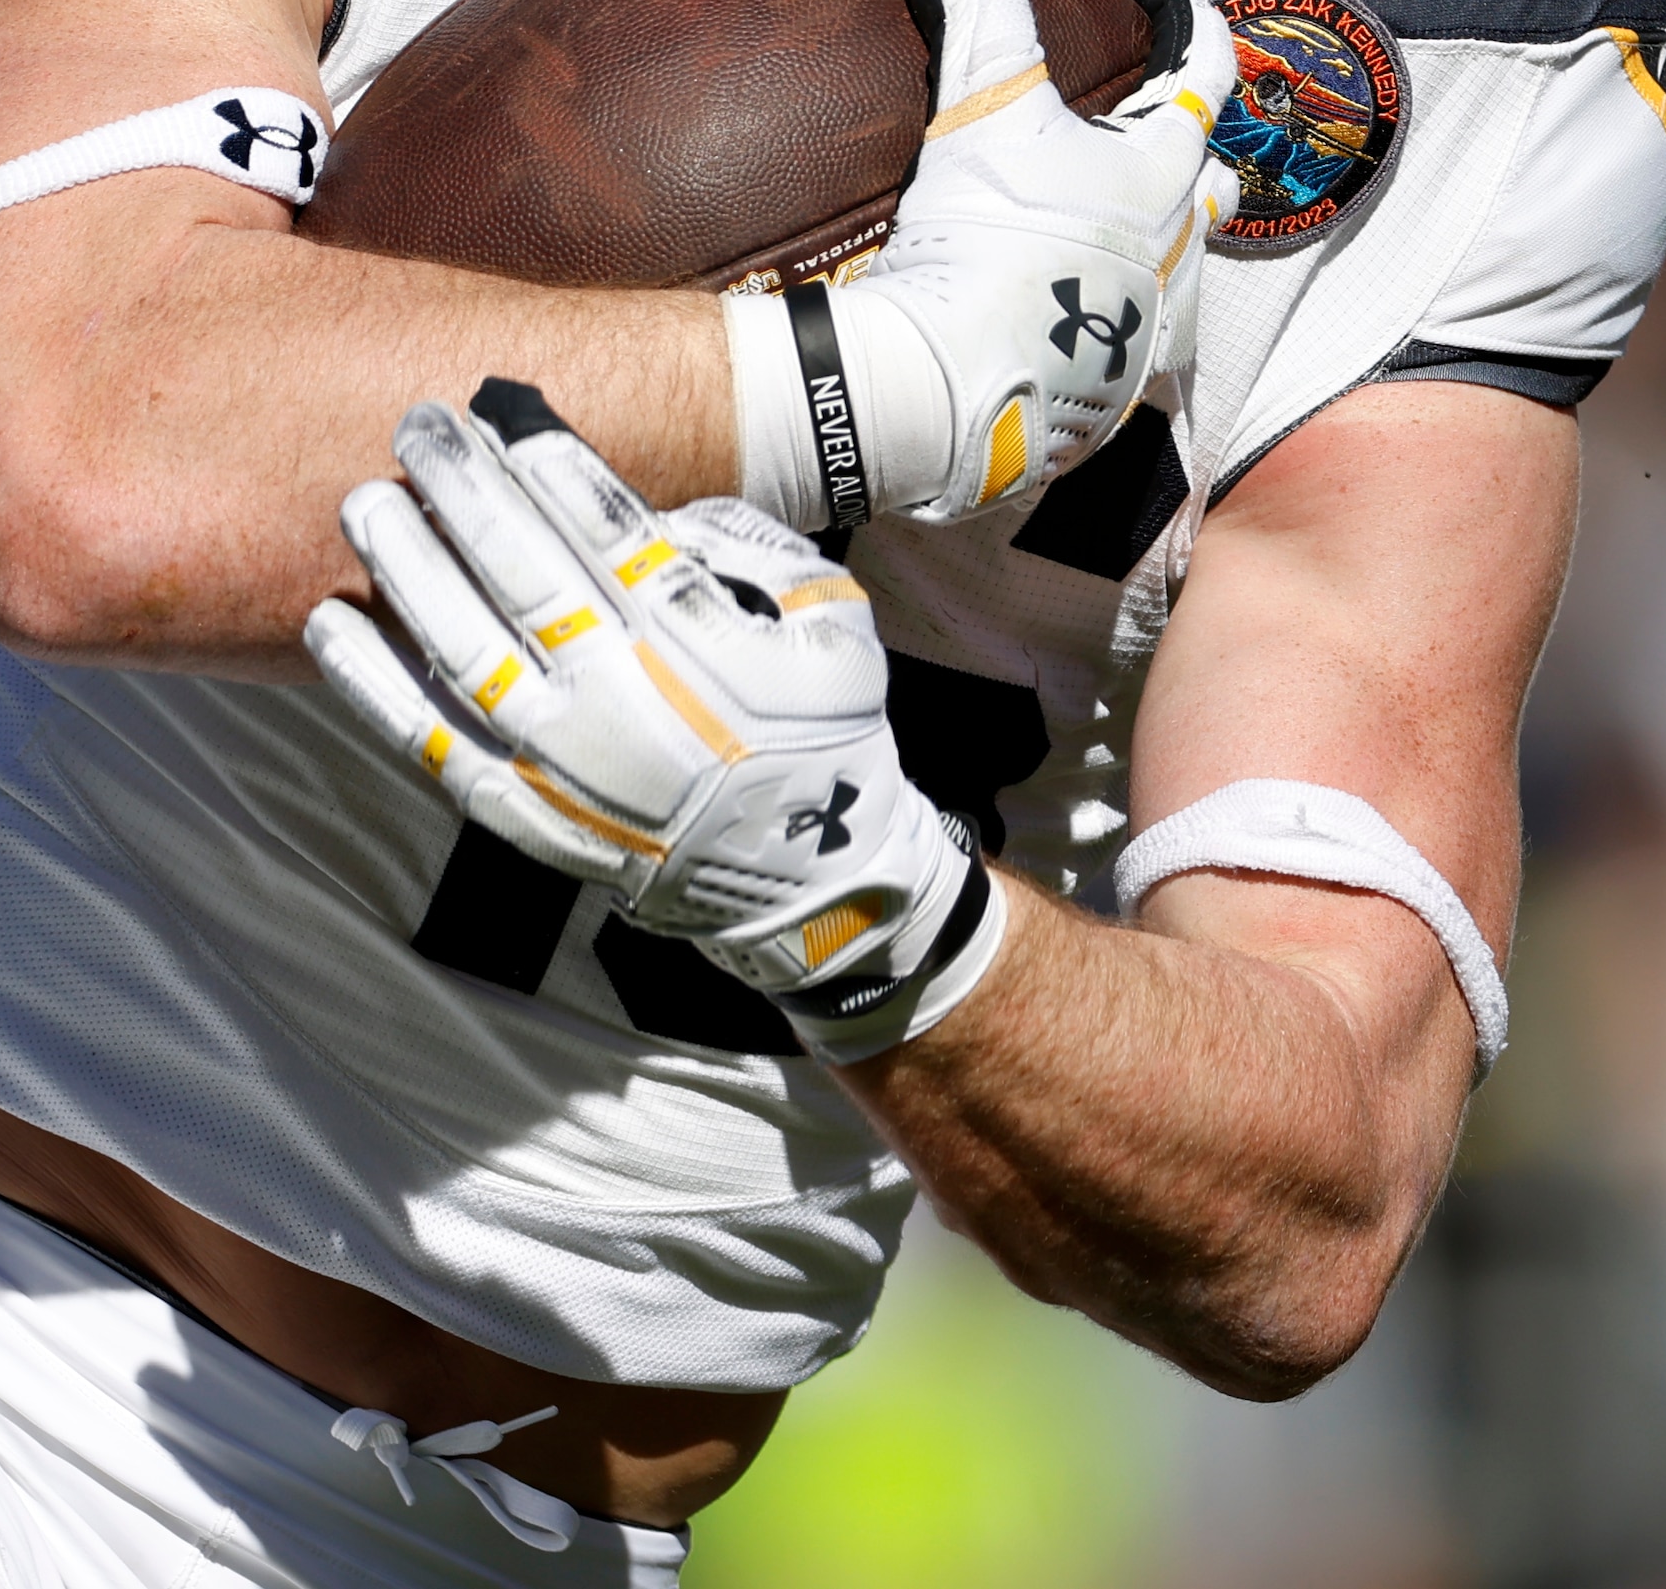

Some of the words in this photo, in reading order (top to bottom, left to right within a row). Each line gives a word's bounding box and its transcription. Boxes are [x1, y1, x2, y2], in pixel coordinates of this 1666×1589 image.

[1335, 11, 1401, 124] KENNEDY
[793, 220, 889, 273] OFFICIAL
[810, 373, 857, 473] NEVER
